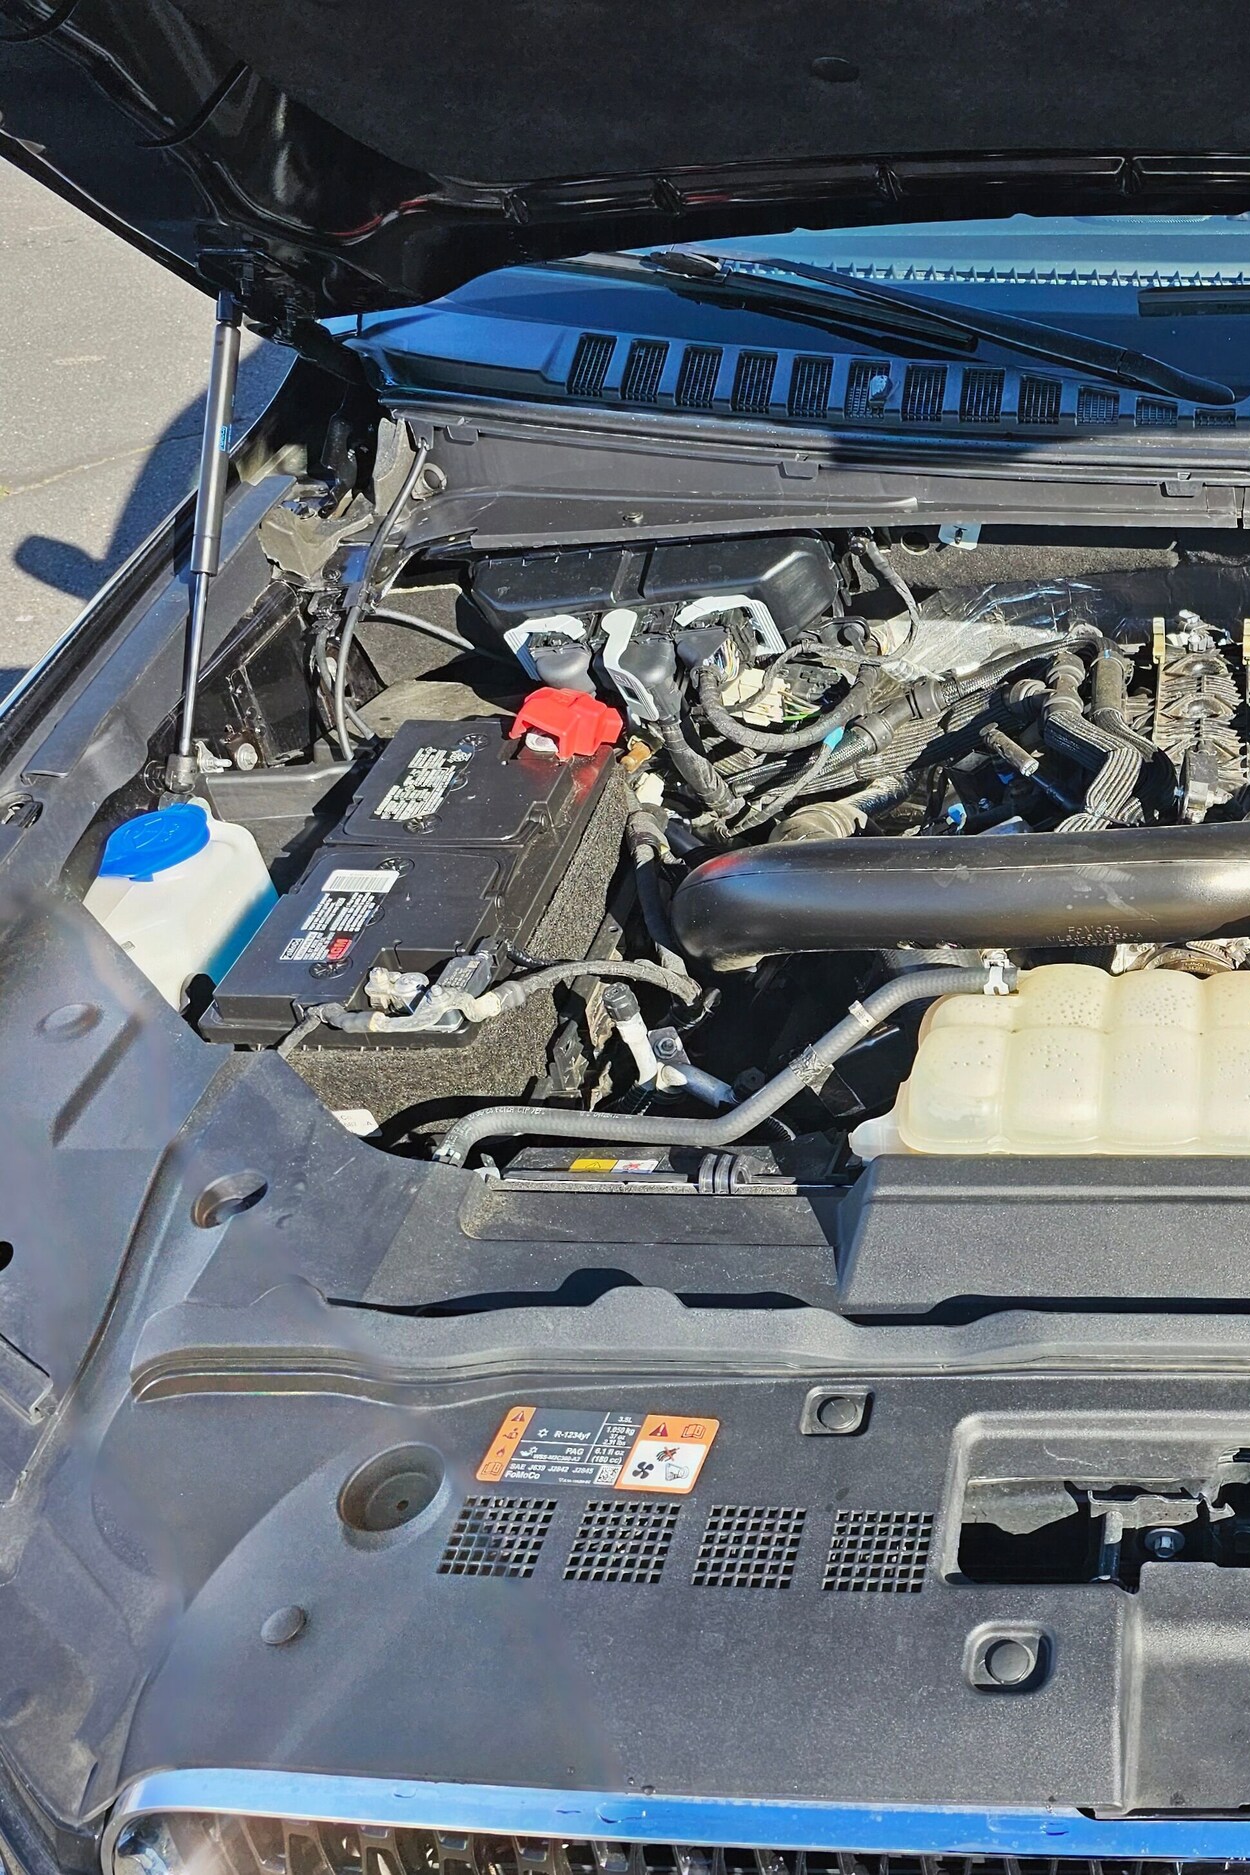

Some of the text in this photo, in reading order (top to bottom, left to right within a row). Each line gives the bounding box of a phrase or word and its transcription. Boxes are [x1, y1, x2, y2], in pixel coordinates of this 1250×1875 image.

[554, 1431, 591, 1440] R-1234yf
[606, 1426, 636, 1436] 1.050 kg
[565, 1447, 585, 1455] PAG
[594, 1447, 606, 1455] 6.1
[591, 1455, 622, 1465] (180 cc)
[509, 1463, 527, 1471] SAE
[527, 1464, 547, 1472] J639
[548, 1465, 570, 1473] J2842
[504, 1470, 541, 1480] FoMoCo
